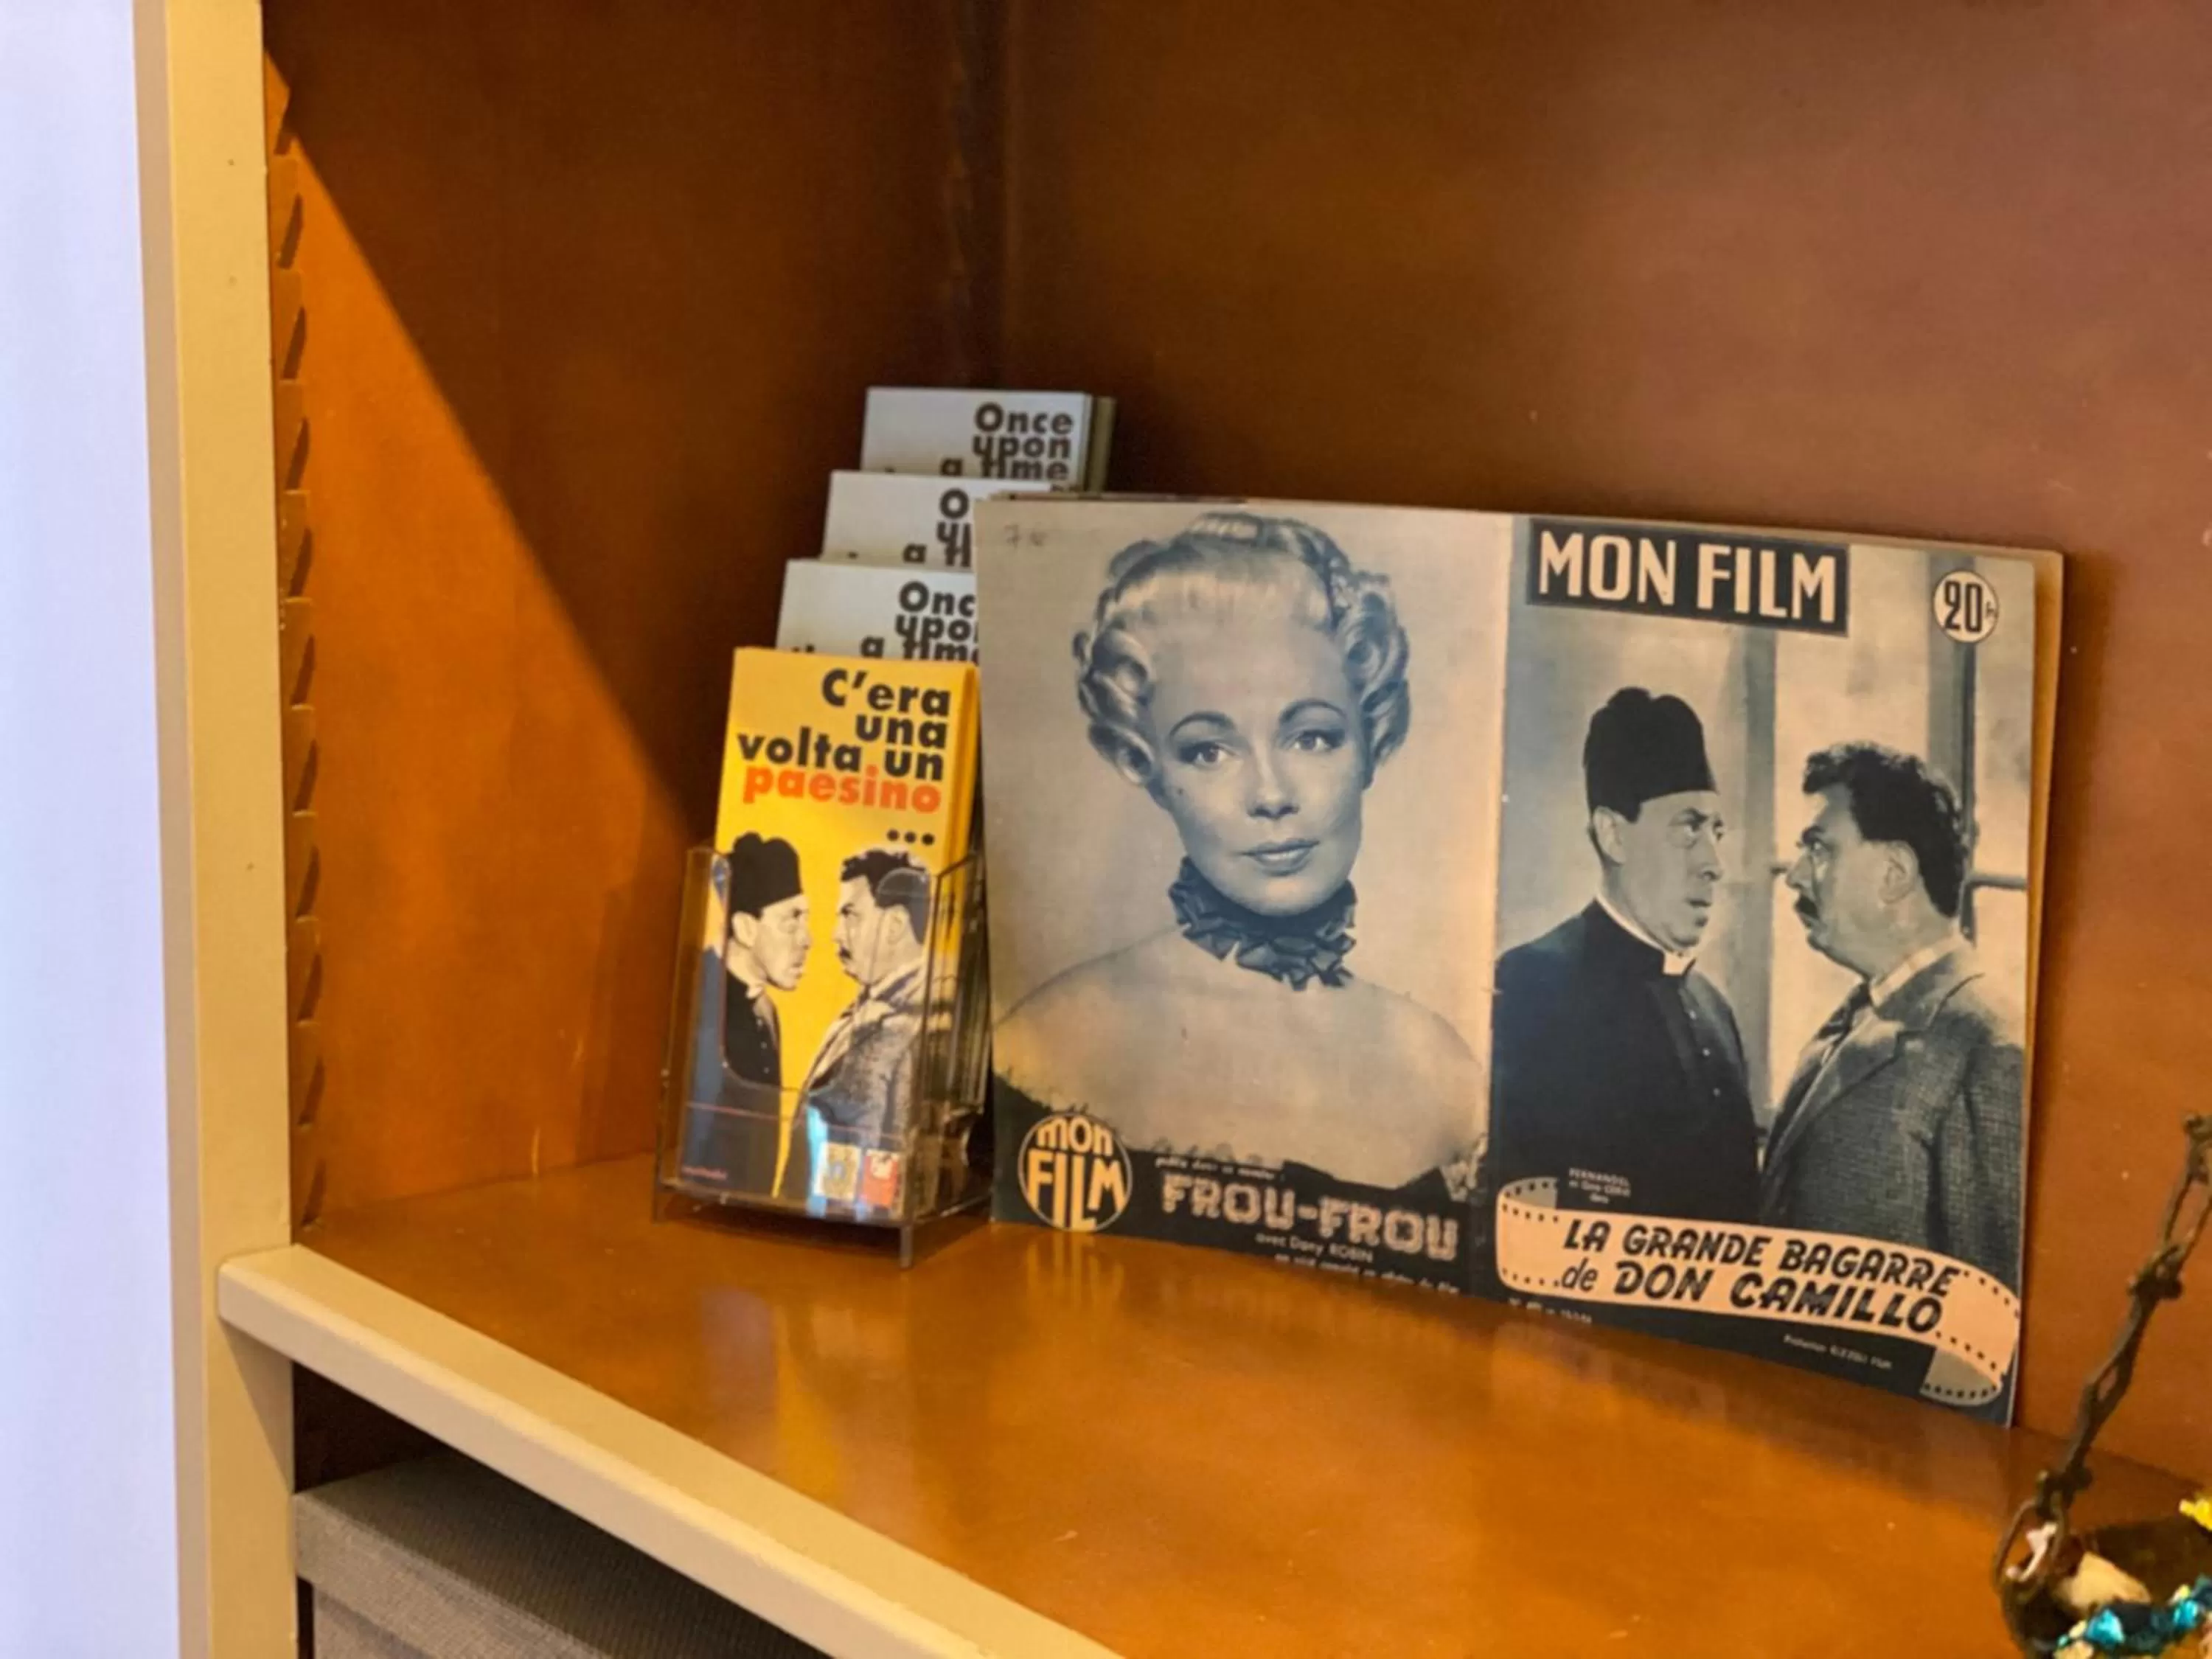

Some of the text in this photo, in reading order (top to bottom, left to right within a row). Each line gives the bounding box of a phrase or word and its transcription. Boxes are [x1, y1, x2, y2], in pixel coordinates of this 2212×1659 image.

[974, 401, 1074, 434] Once
[940, 457, 1068, 479] a time
[972, 435, 1071, 463] upon
[899, 580, 976, 617] Onc
[1539, 530, 1837, 623] MON FILM
[860, 636, 885, 658] a
[895, 613, 978, 644] upo
[821, 667, 951, 717] C'era
[737, 725, 944, 782] volta un
[855, 714, 947, 749] una
[742, 764, 942, 814] paesino
[1027, 1147, 1126, 1232] FILM
[1161, 1171, 1458, 1262] FROU-FROU
[1562, 1219, 1959, 1298] LA GRANDE BAGARRE
[1562, 1257, 1944, 1333] de DON CAMILLO
